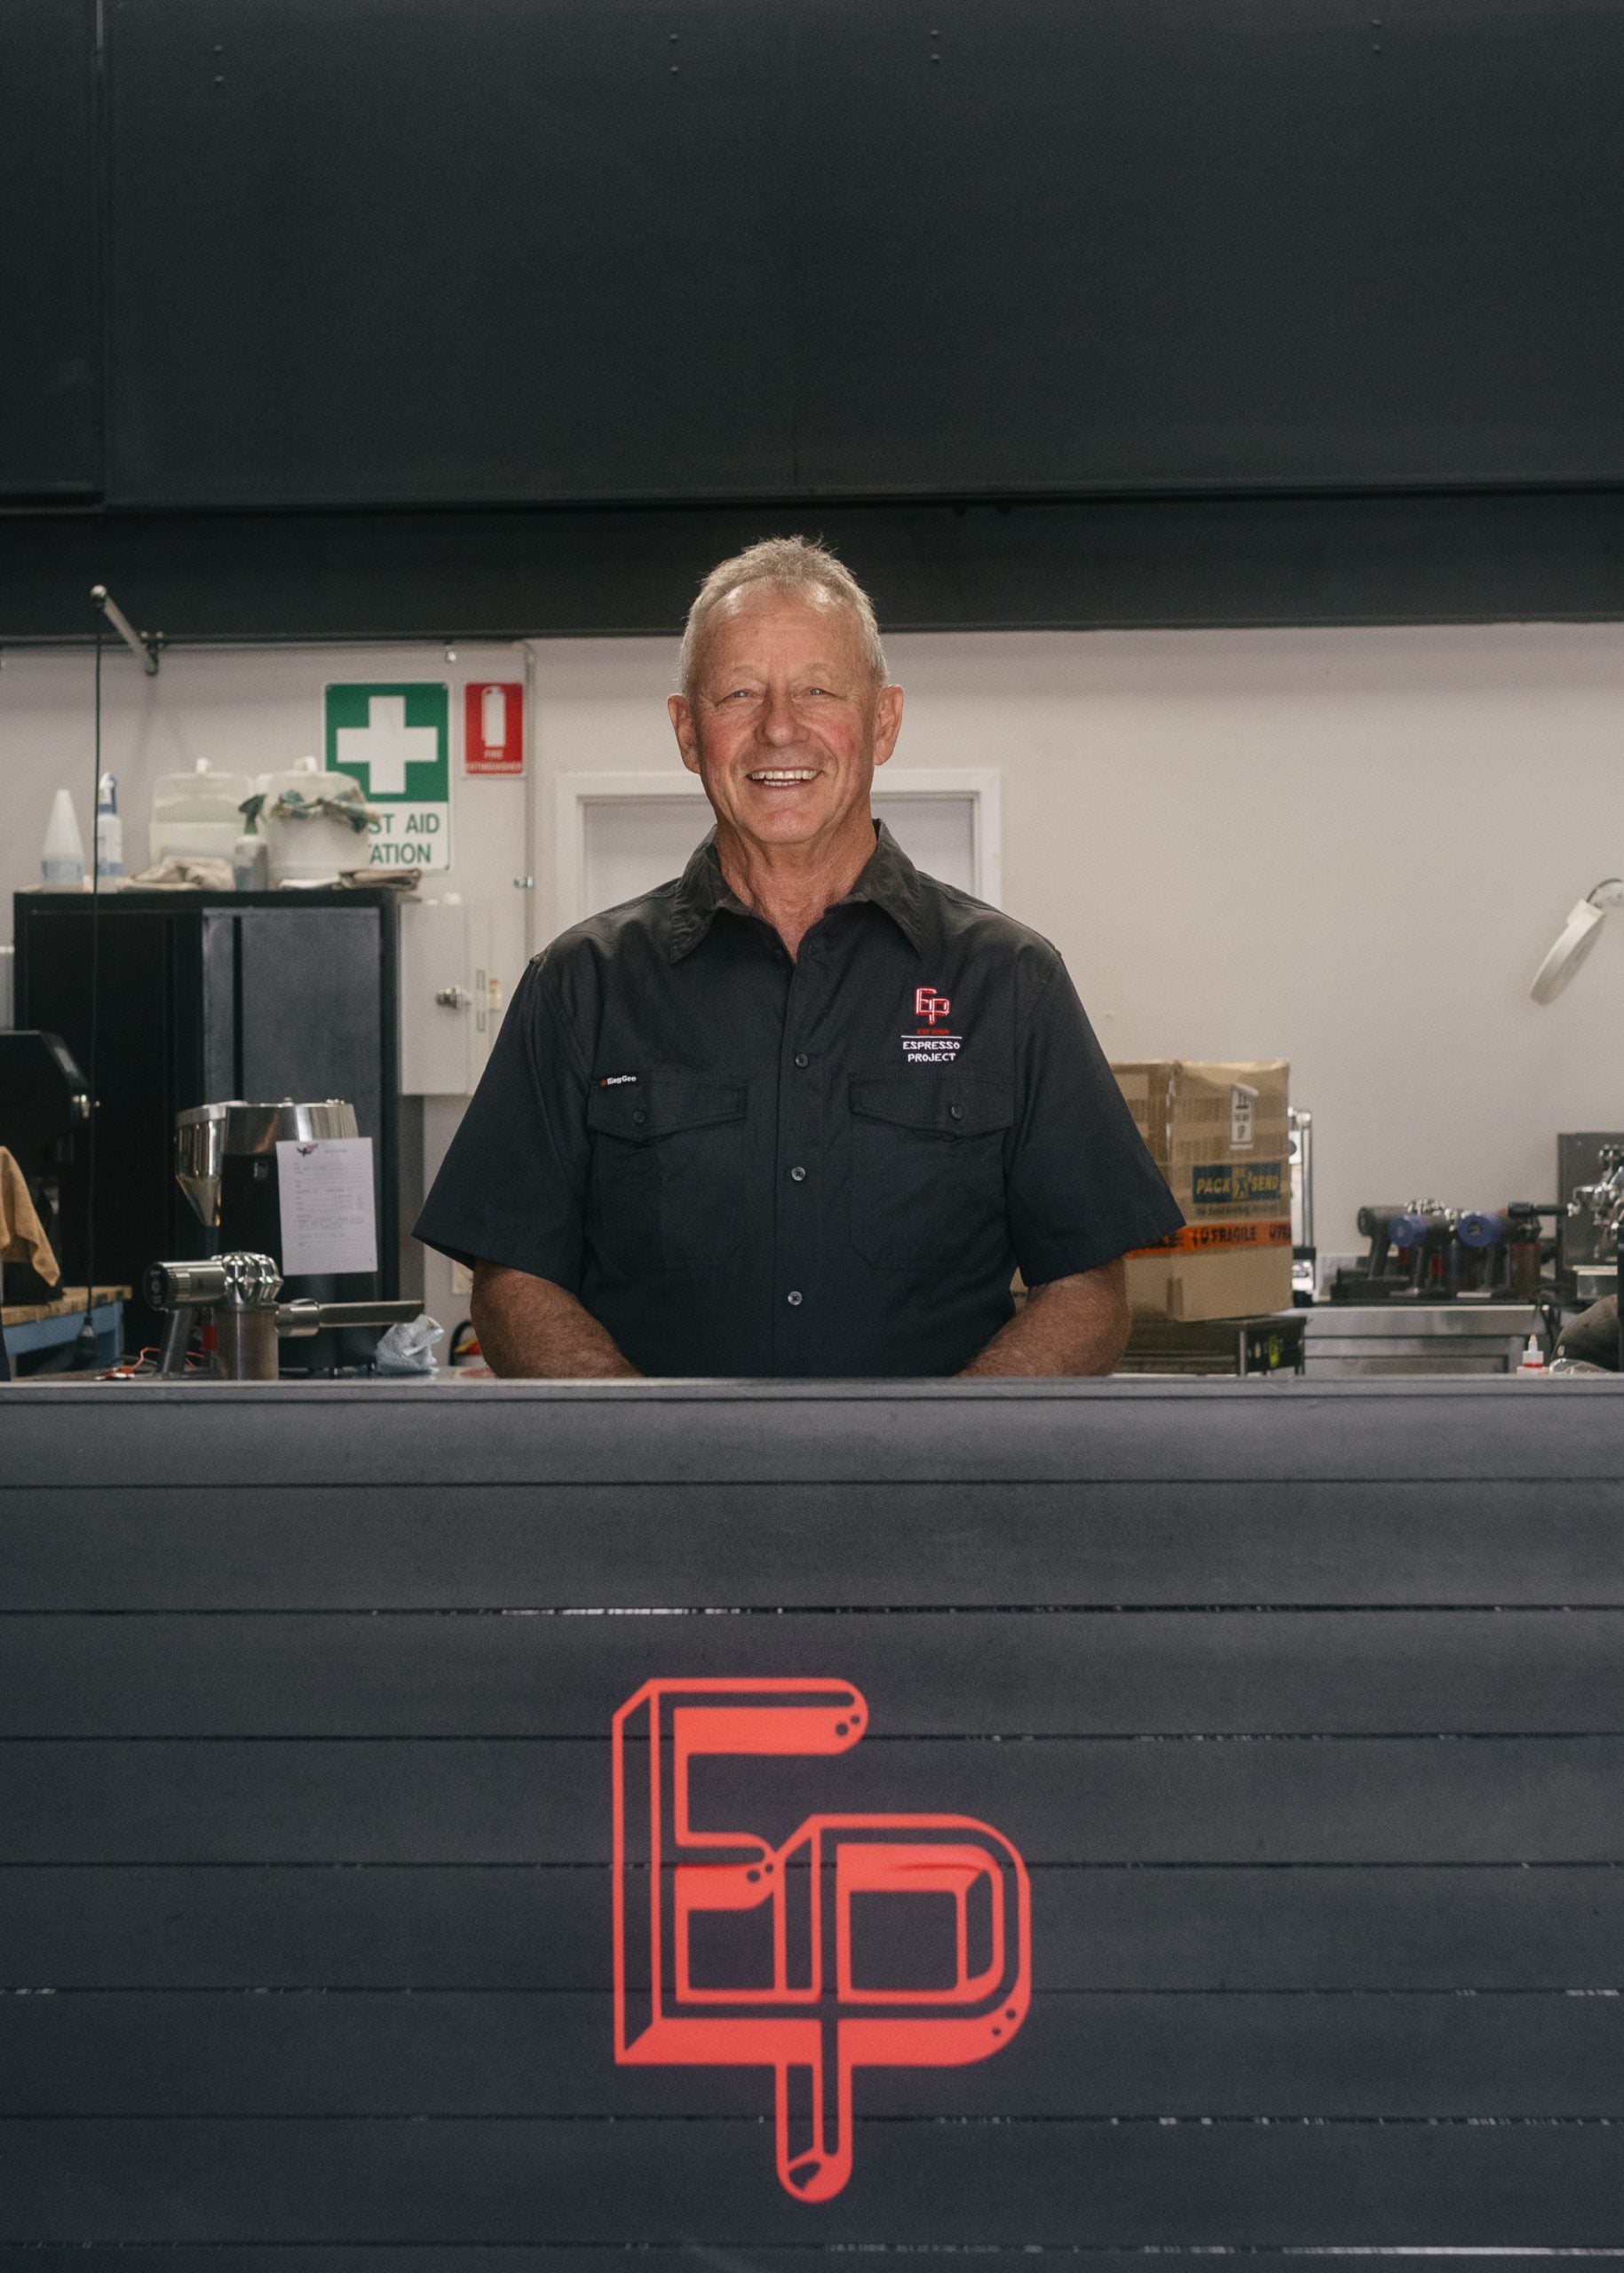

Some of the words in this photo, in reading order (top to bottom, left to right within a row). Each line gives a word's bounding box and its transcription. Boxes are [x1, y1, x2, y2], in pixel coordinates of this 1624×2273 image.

[405, 812, 440, 834] AID
[368, 843, 432, 864] ATION
[902, 1041, 961, 1050] ESPRESSO
[907, 1052, 956, 1063] PROJECT
[1195, 1177, 1231, 1194] PACK
[1212, 1224, 1256, 1242] FRAGILE
